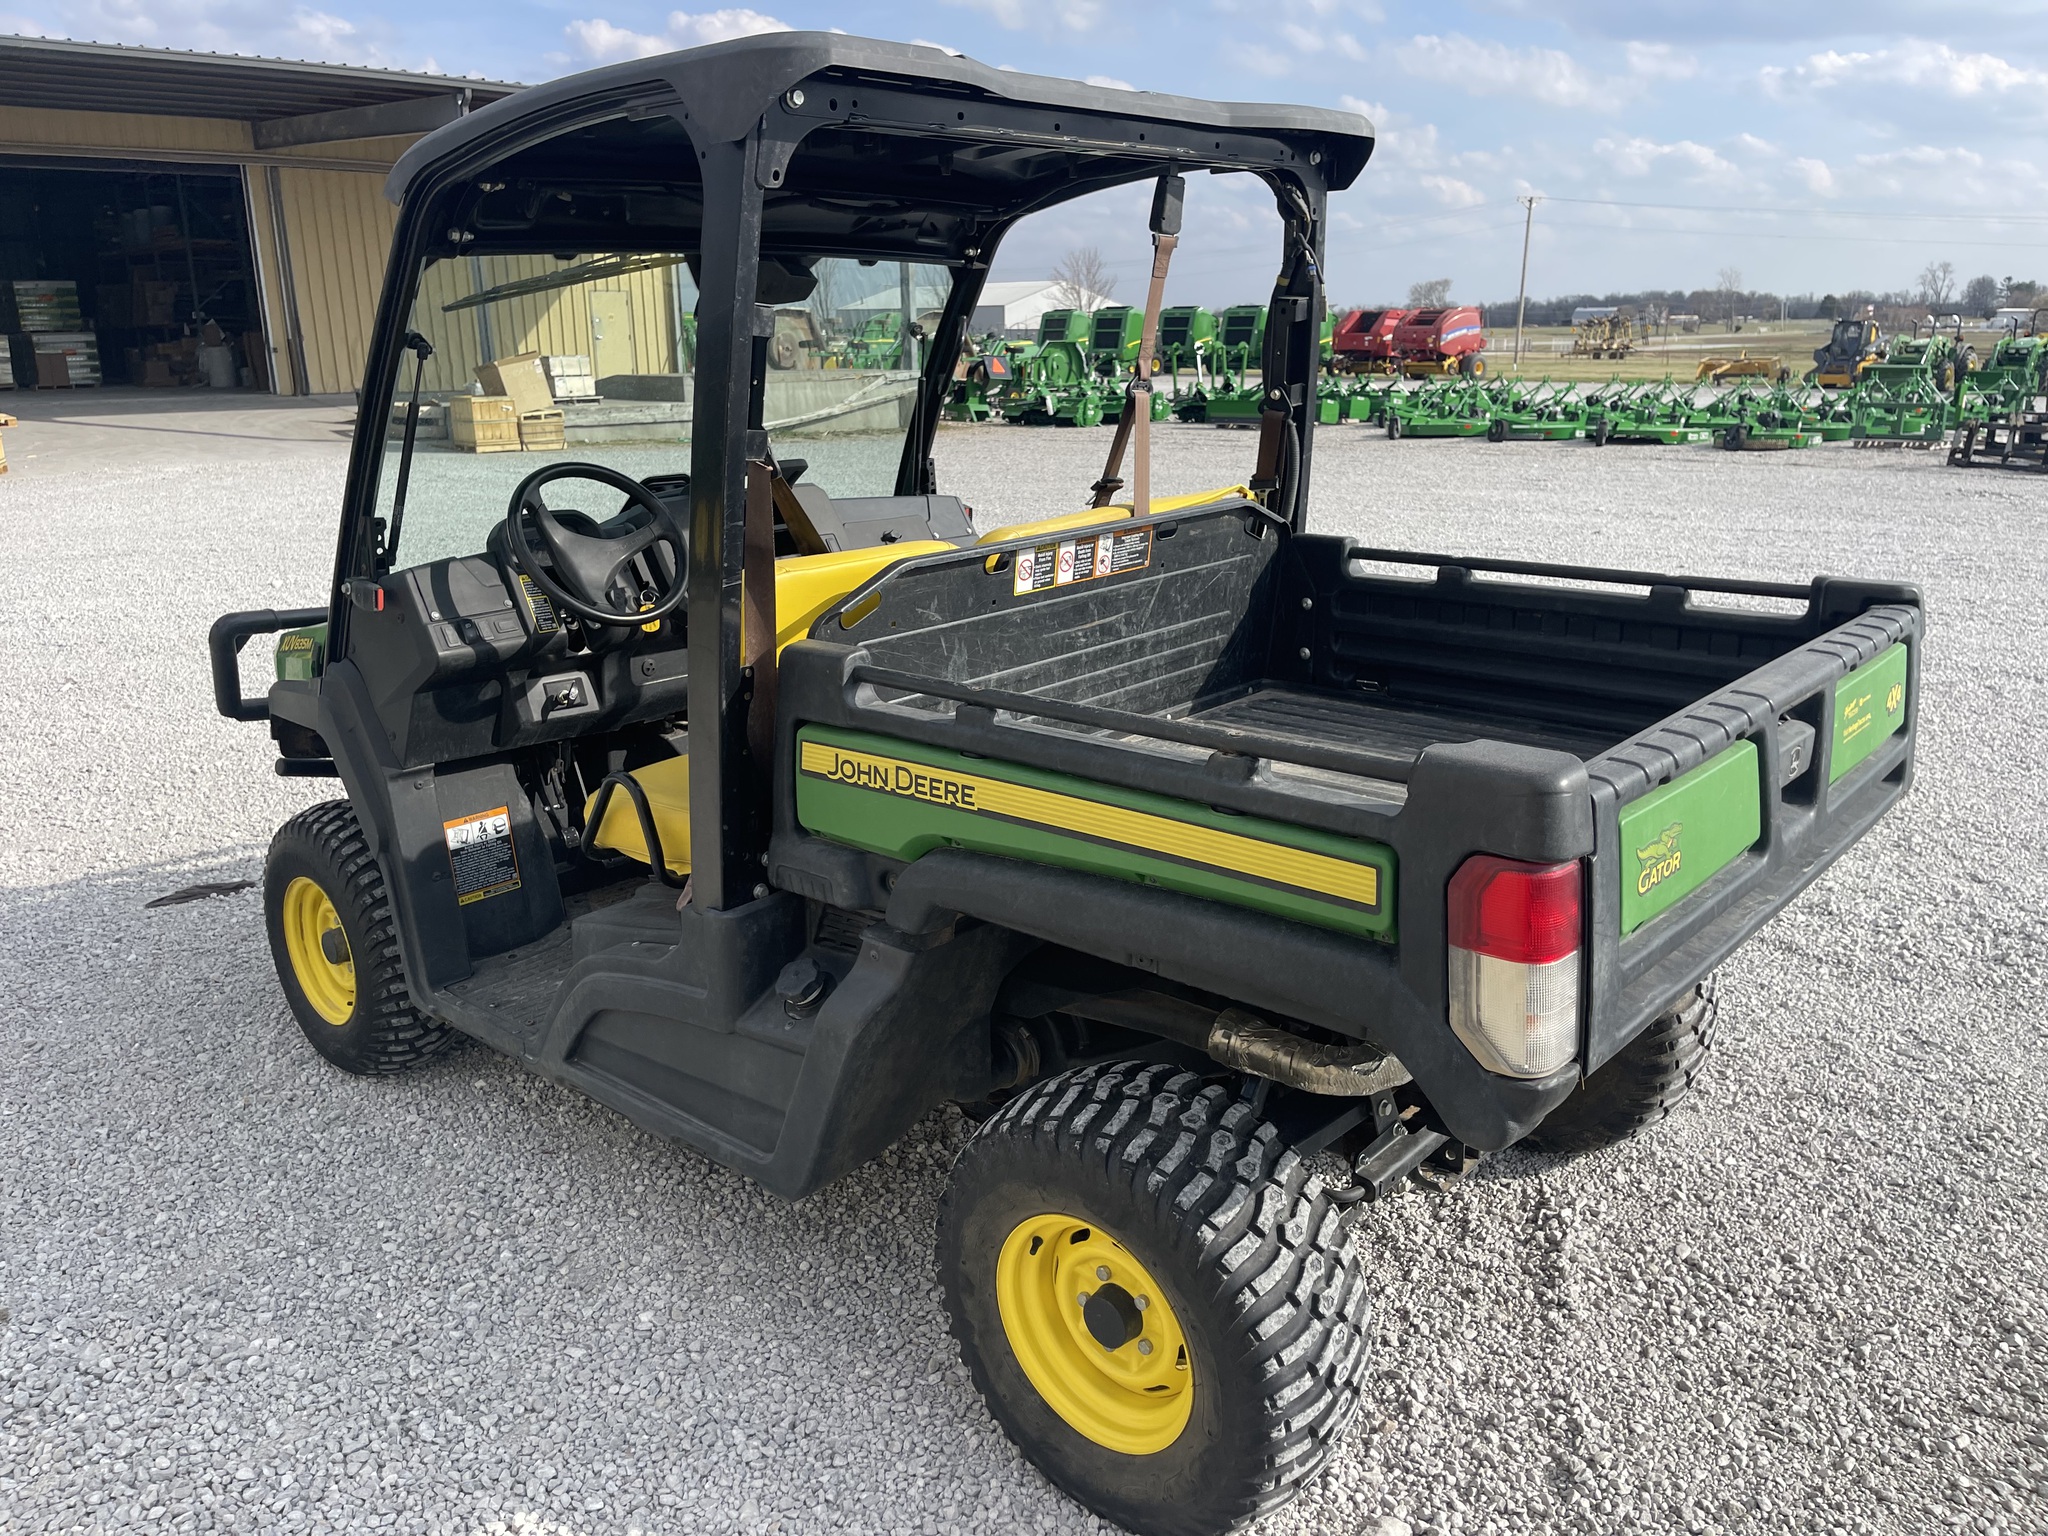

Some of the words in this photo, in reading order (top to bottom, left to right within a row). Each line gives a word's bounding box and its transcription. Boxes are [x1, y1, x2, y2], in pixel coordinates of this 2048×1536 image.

[827, 753, 889, 788] JOHN
[895, 765, 976, 807] DEERE
[468, 813, 490, 821] WARNING
[1638, 851, 1681, 894] GATOR
[464, 893, 483, 902] CAUTION
